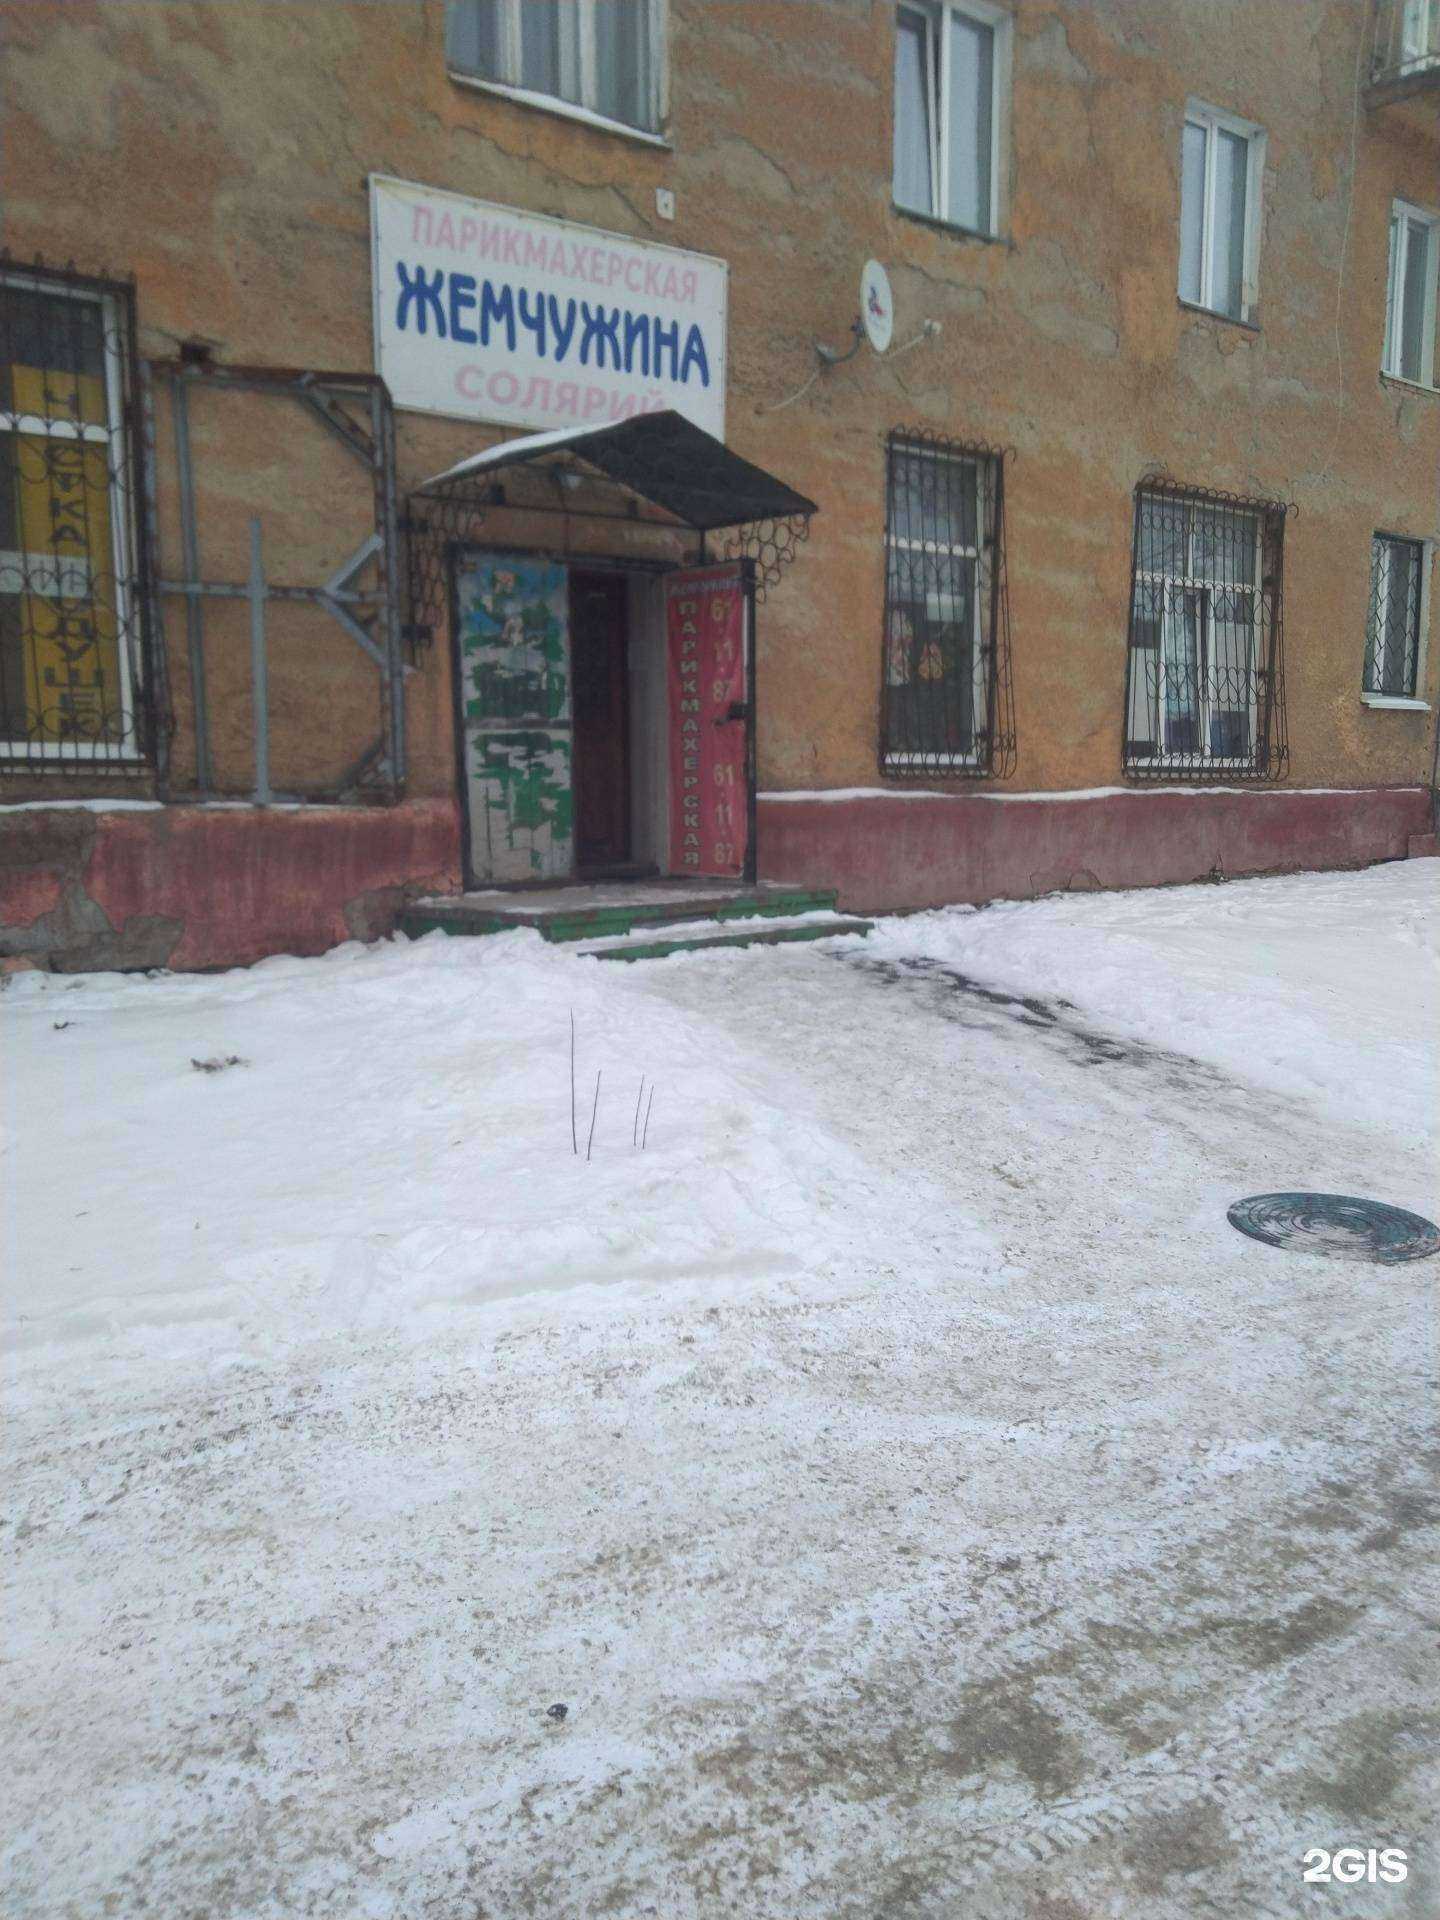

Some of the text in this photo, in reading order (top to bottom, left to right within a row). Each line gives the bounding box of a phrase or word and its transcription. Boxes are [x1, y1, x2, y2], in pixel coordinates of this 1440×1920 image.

[411, 204, 698, 303] ПАРИКМАХЕРСКАЯ
[395, 260, 710, 388] ЖЕМЧУЖИНА
[677, 600, 701, 866] ПАРИКМАХЕРСКАЯ
